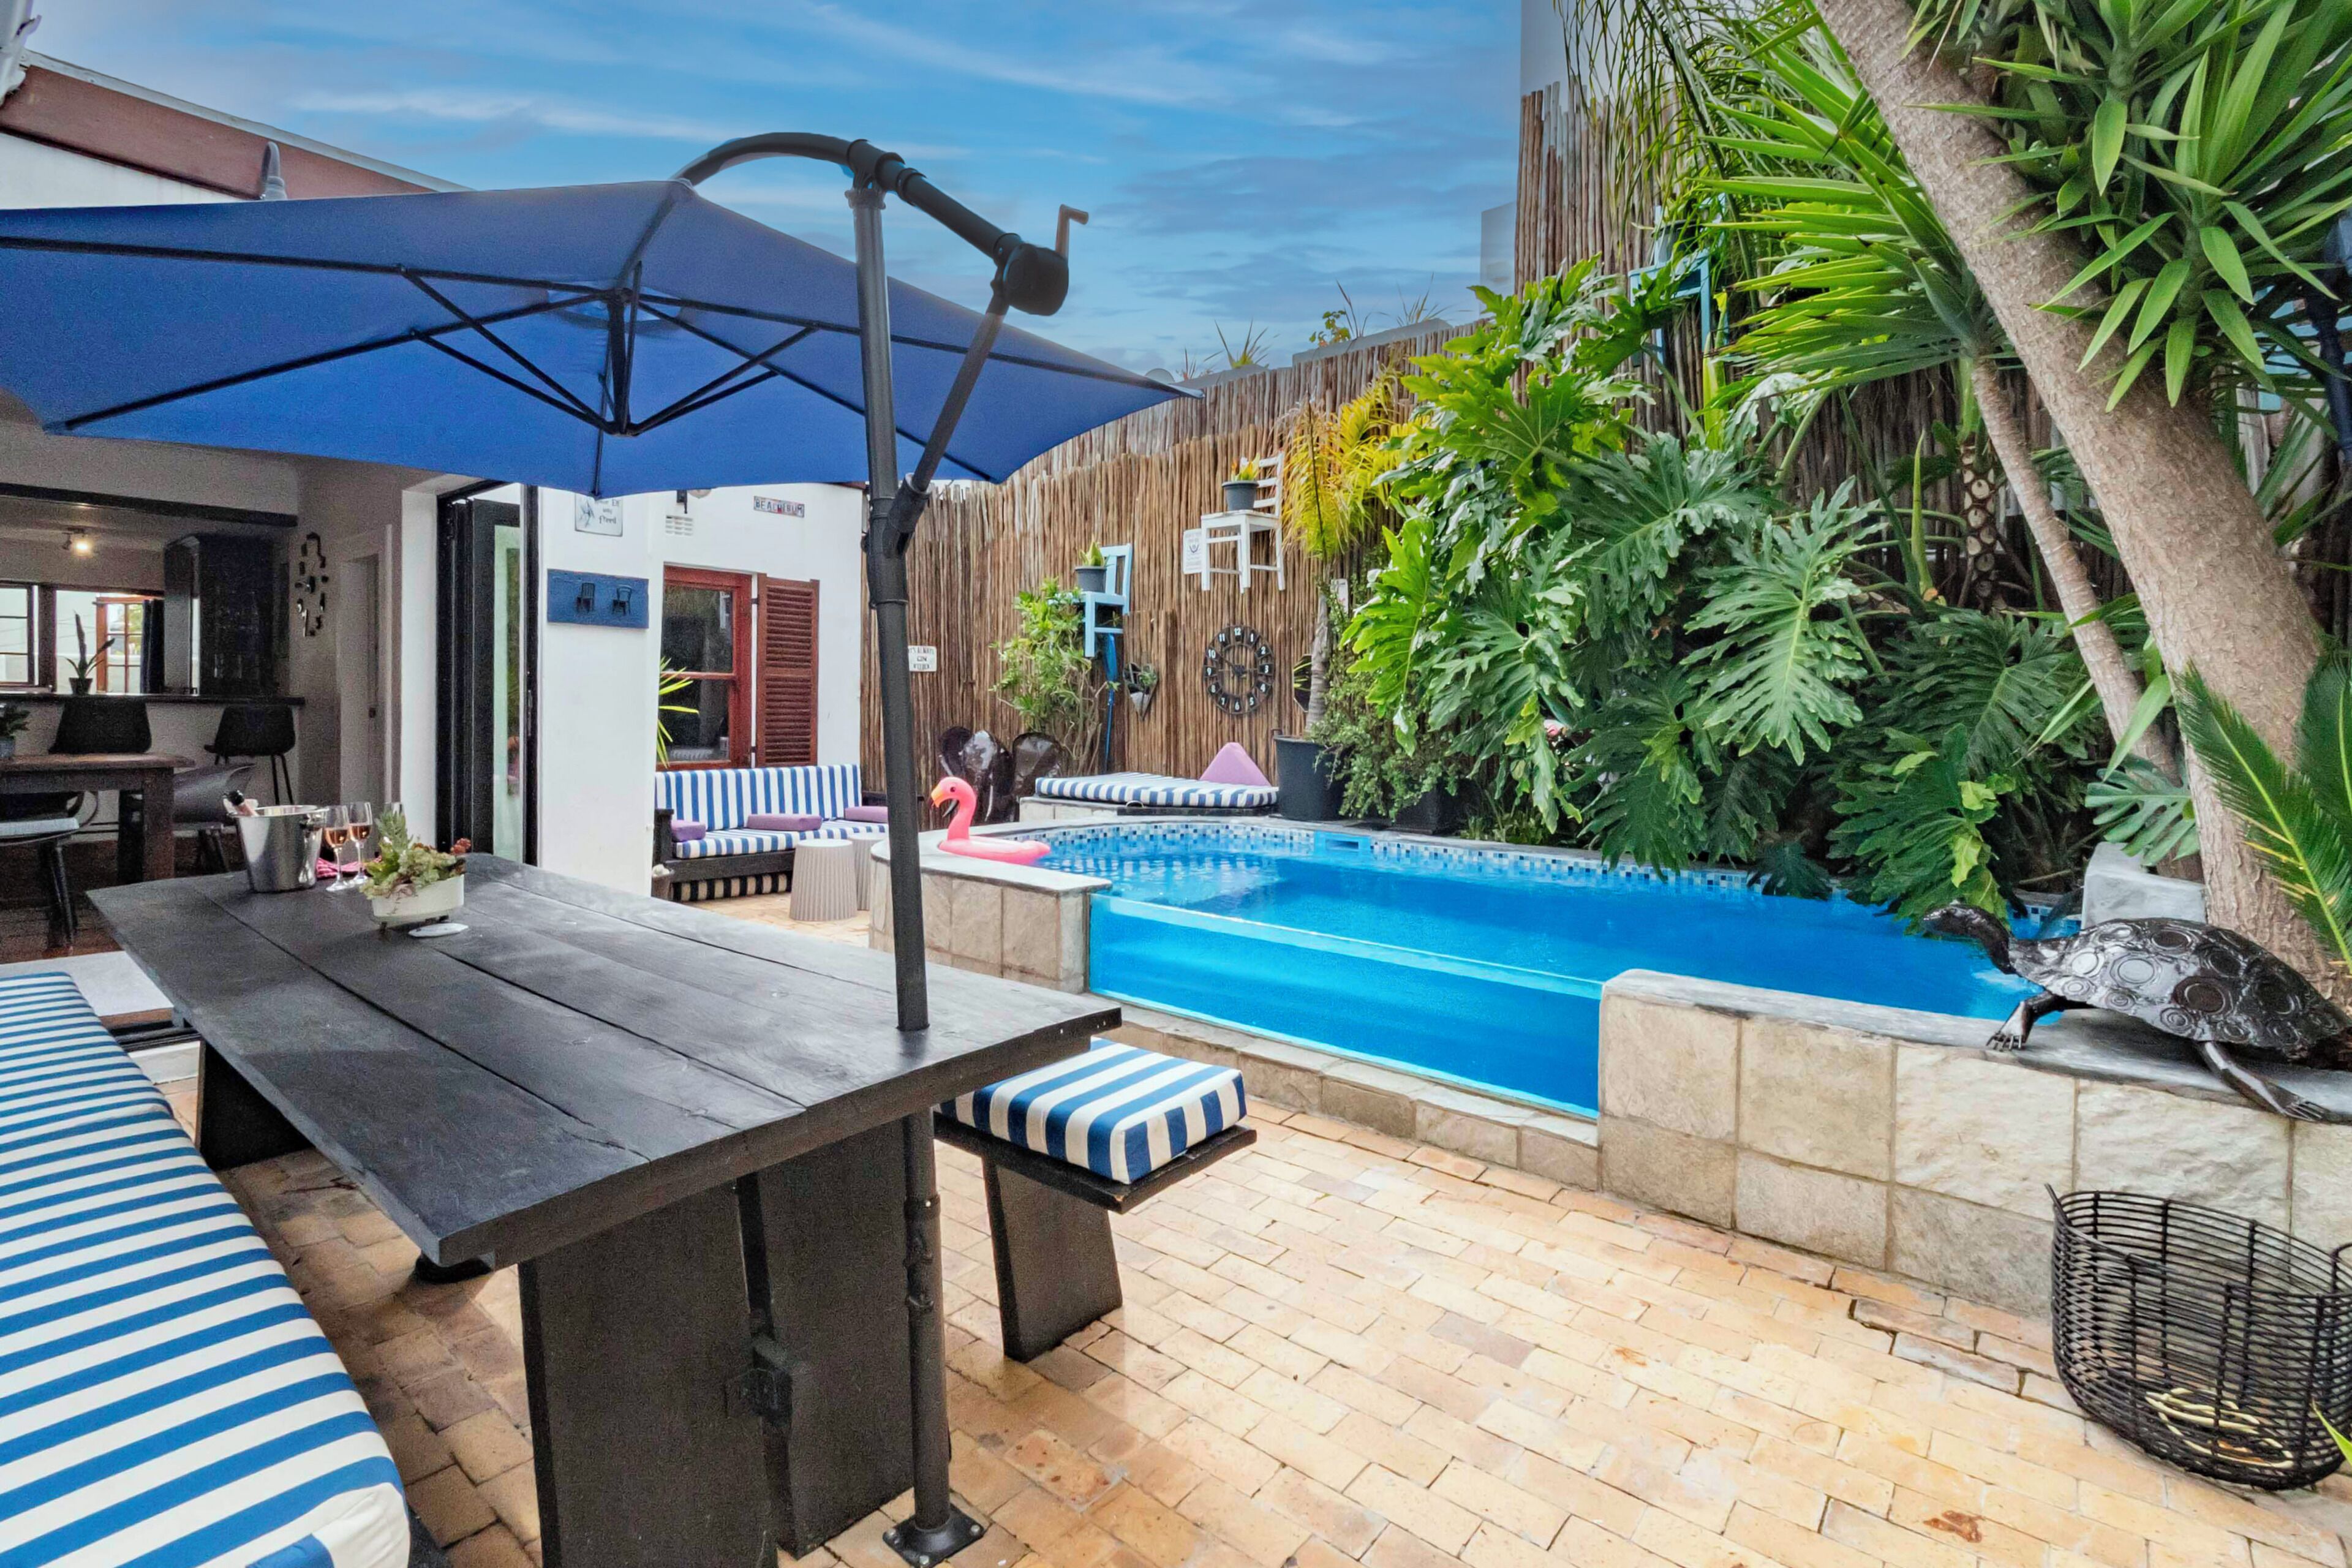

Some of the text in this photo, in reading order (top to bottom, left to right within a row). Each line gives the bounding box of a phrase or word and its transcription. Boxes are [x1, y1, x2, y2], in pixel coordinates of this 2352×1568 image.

[1234, 627, 1241, 636] 12
[1219, 633, 1226, 643] 11
[1250, 633, 1254, 642] 1
[1208, 649, 1216, 658] 10
[1261, 646, 1266, 655] 2
[1207, 667, 1212, 676] 9
[1265, 665, 1269, 674] 3
[1260, 684, 1265, 692] 4
[1235, 701, 1240, 710] 6
